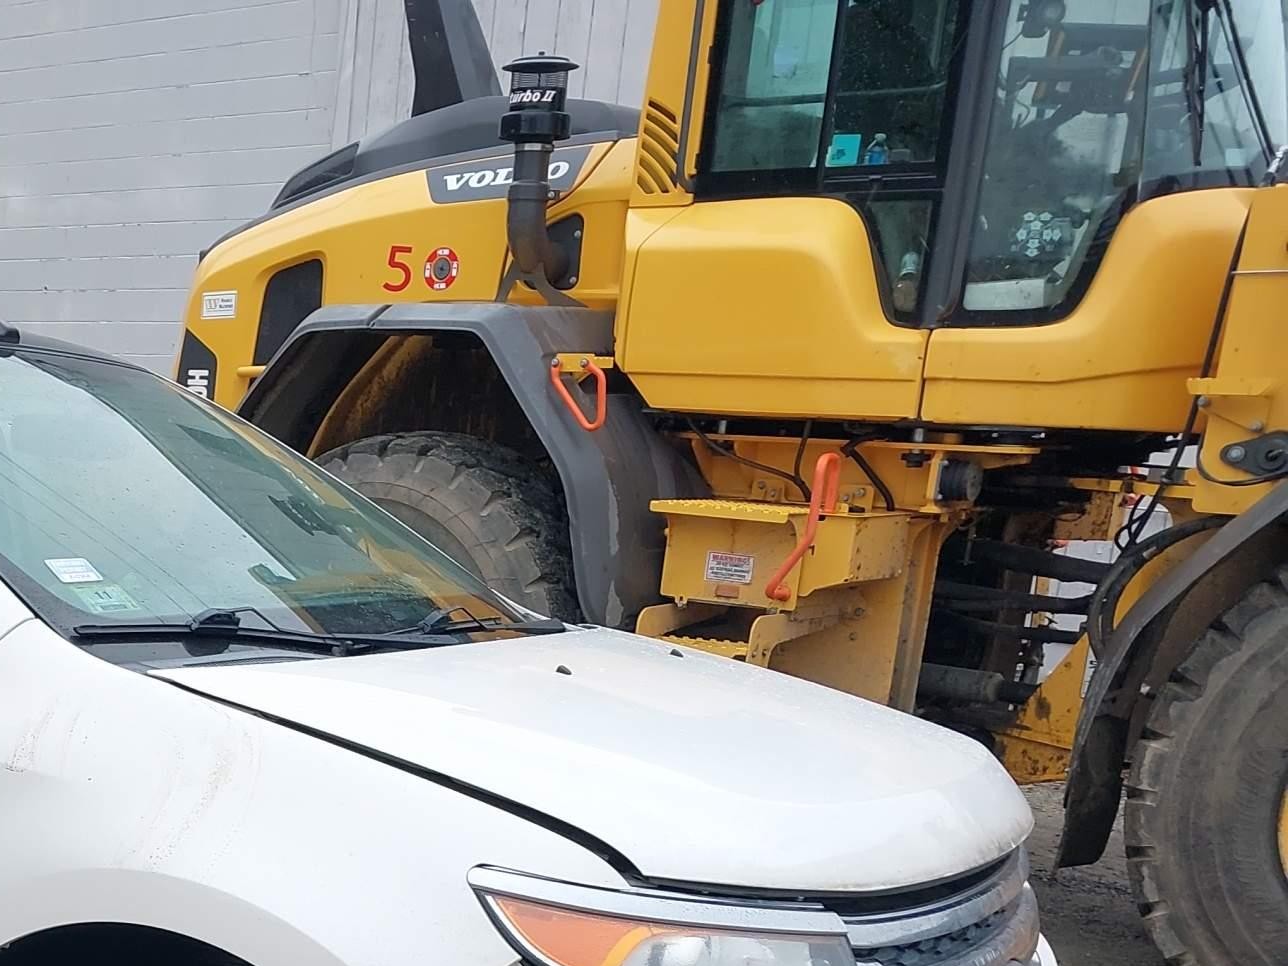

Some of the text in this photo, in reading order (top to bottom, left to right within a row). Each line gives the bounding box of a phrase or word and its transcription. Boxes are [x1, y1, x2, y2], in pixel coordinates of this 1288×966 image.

[509, 90, 542, 104] turbo
[443, 161, 570, 191] VOLO
[383, 246, 413, 292] 5
